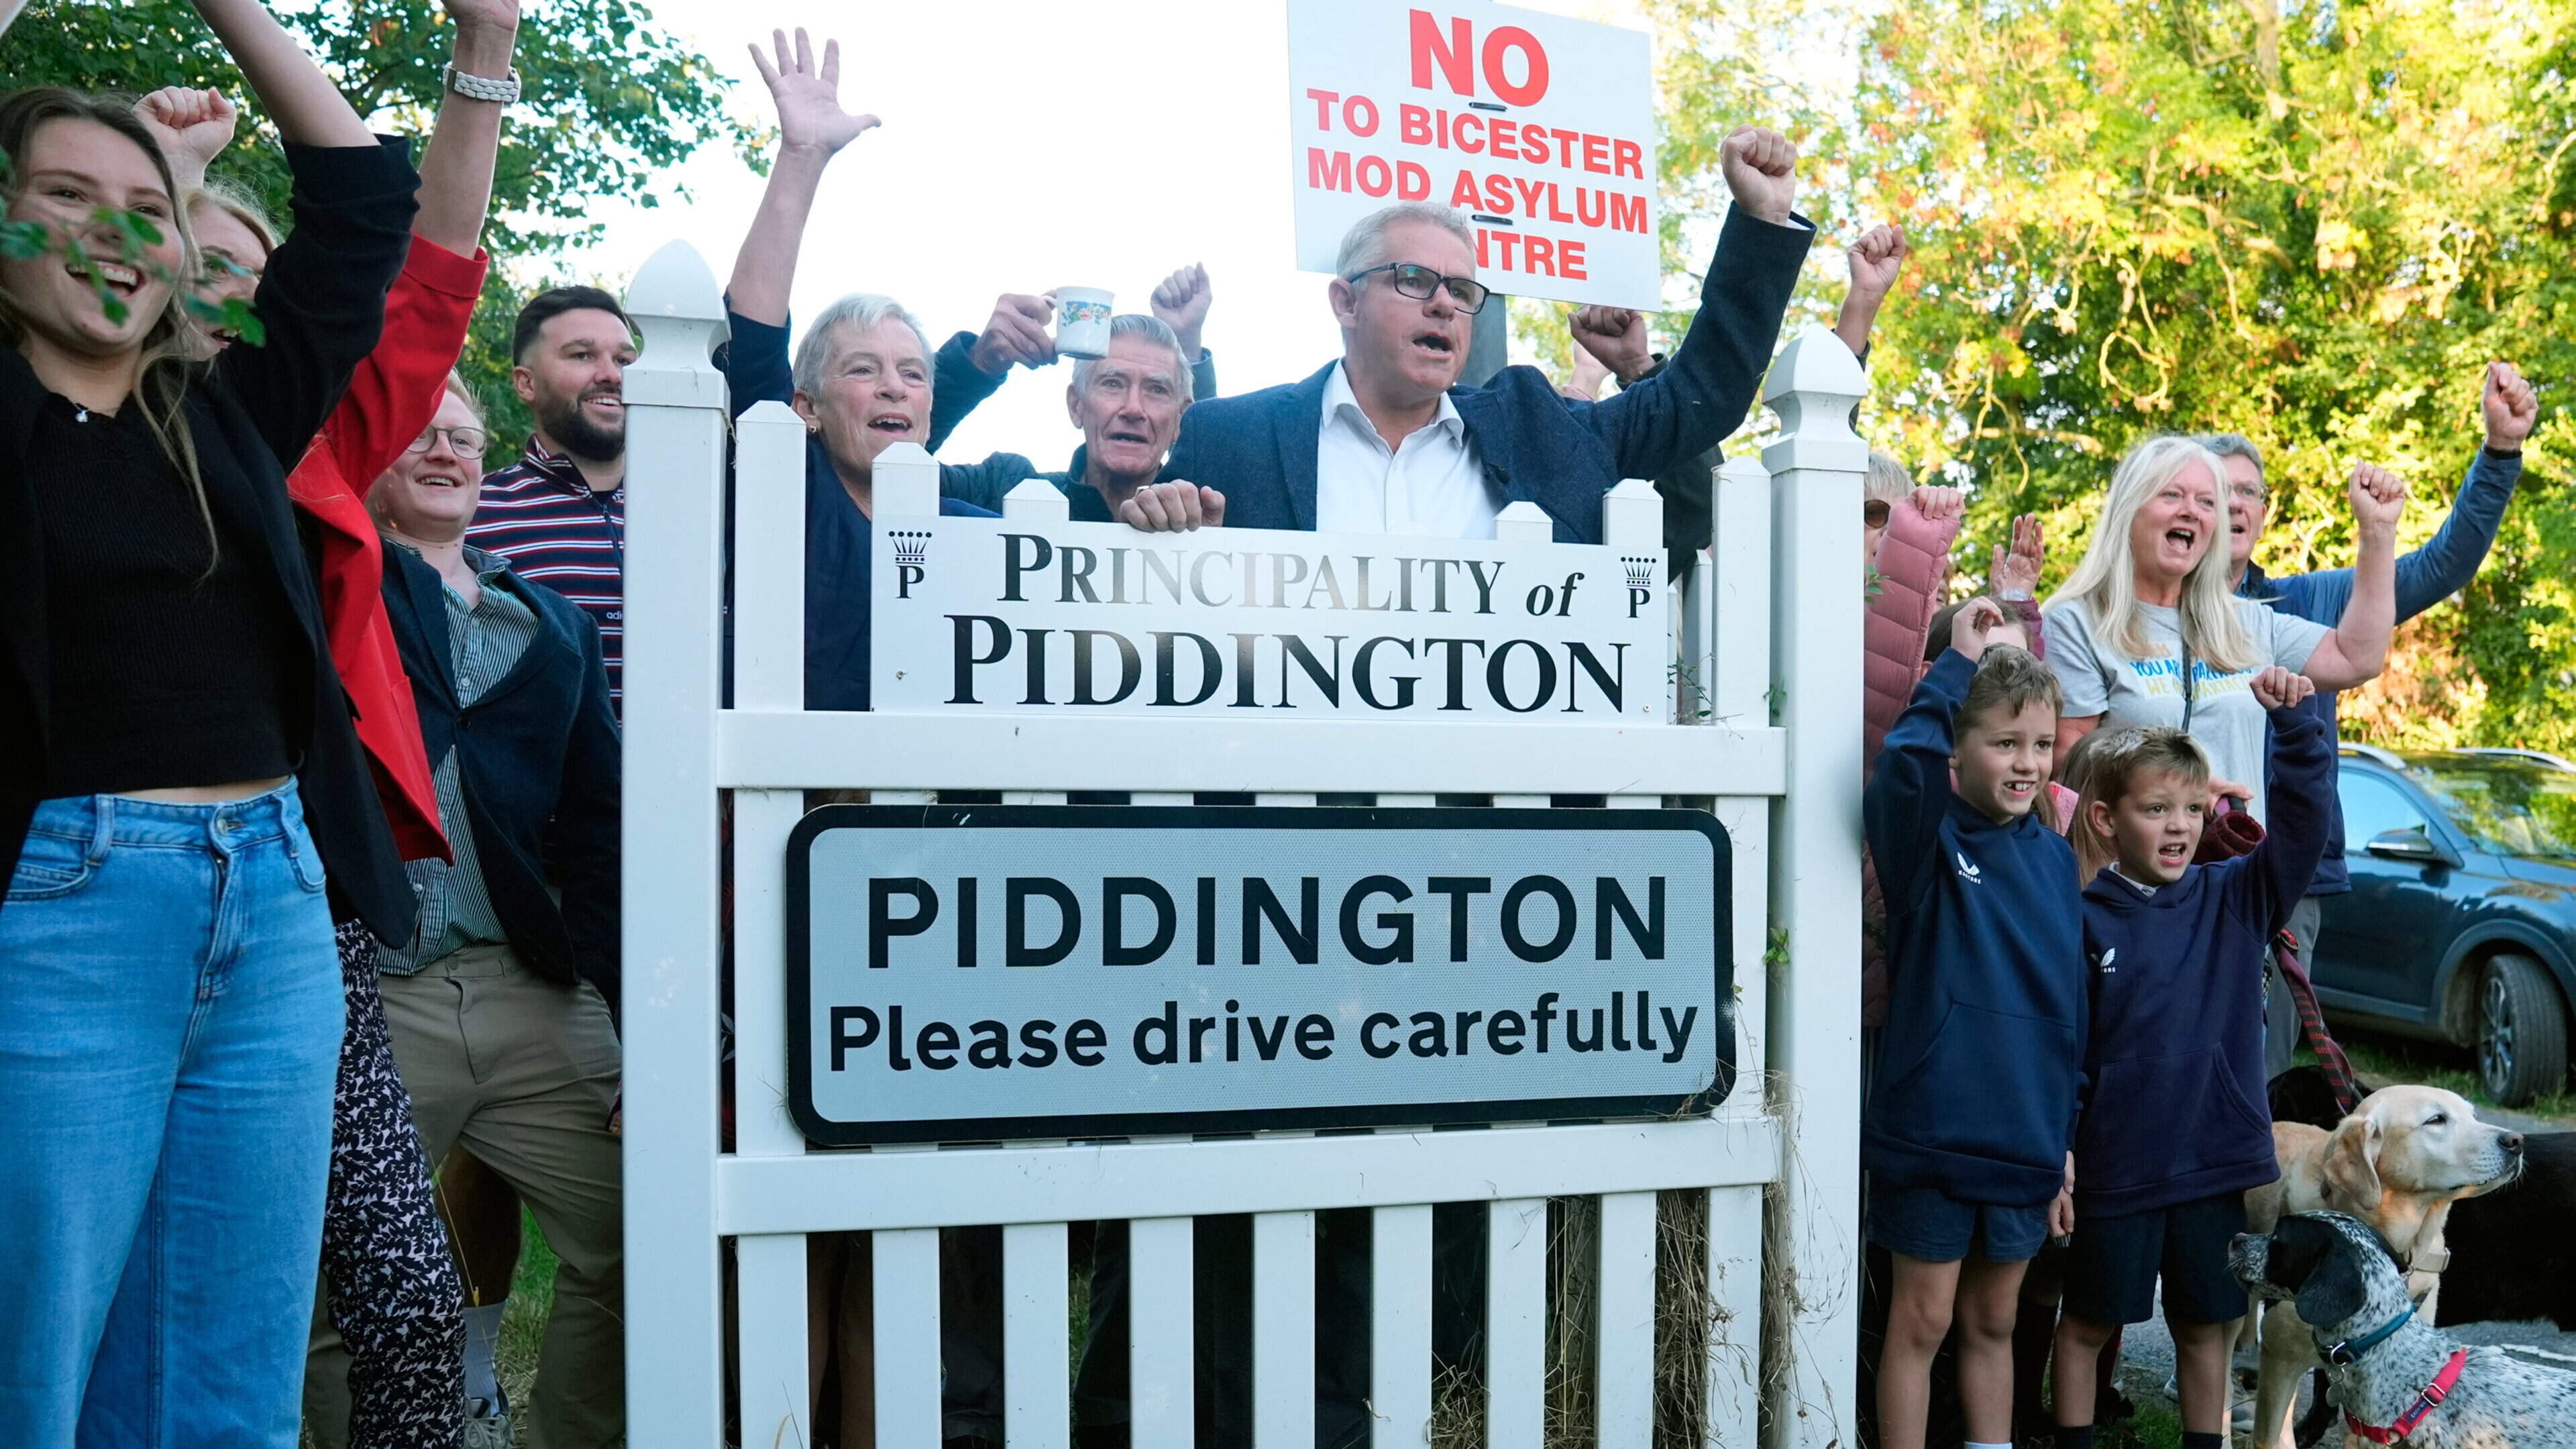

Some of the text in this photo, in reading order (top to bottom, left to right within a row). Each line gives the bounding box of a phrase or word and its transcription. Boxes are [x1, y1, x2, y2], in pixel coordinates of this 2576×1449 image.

[1409, 8, 1550, 108] NO
[1307, 88, 1644, 180] TO BICESTER
[1307, 147, 1648, 234] MOD ASYLUM
[1467, 228, 1587, 280] NTRE
[896, 566, 924, 599] P
[997, 533, 1585, 616] PRINCIPALITY of
[1627, 588, 1651, 619] P
[944, 614, 1631, 713] PIDDINGTON
[2131, 659, 2163, 677] YOU
[2165, 659, 2183, 682] AR
[869, 875, 1666, 969] PIDDINGTON
[830, 990, 1699, 1071] Please drive carefully
